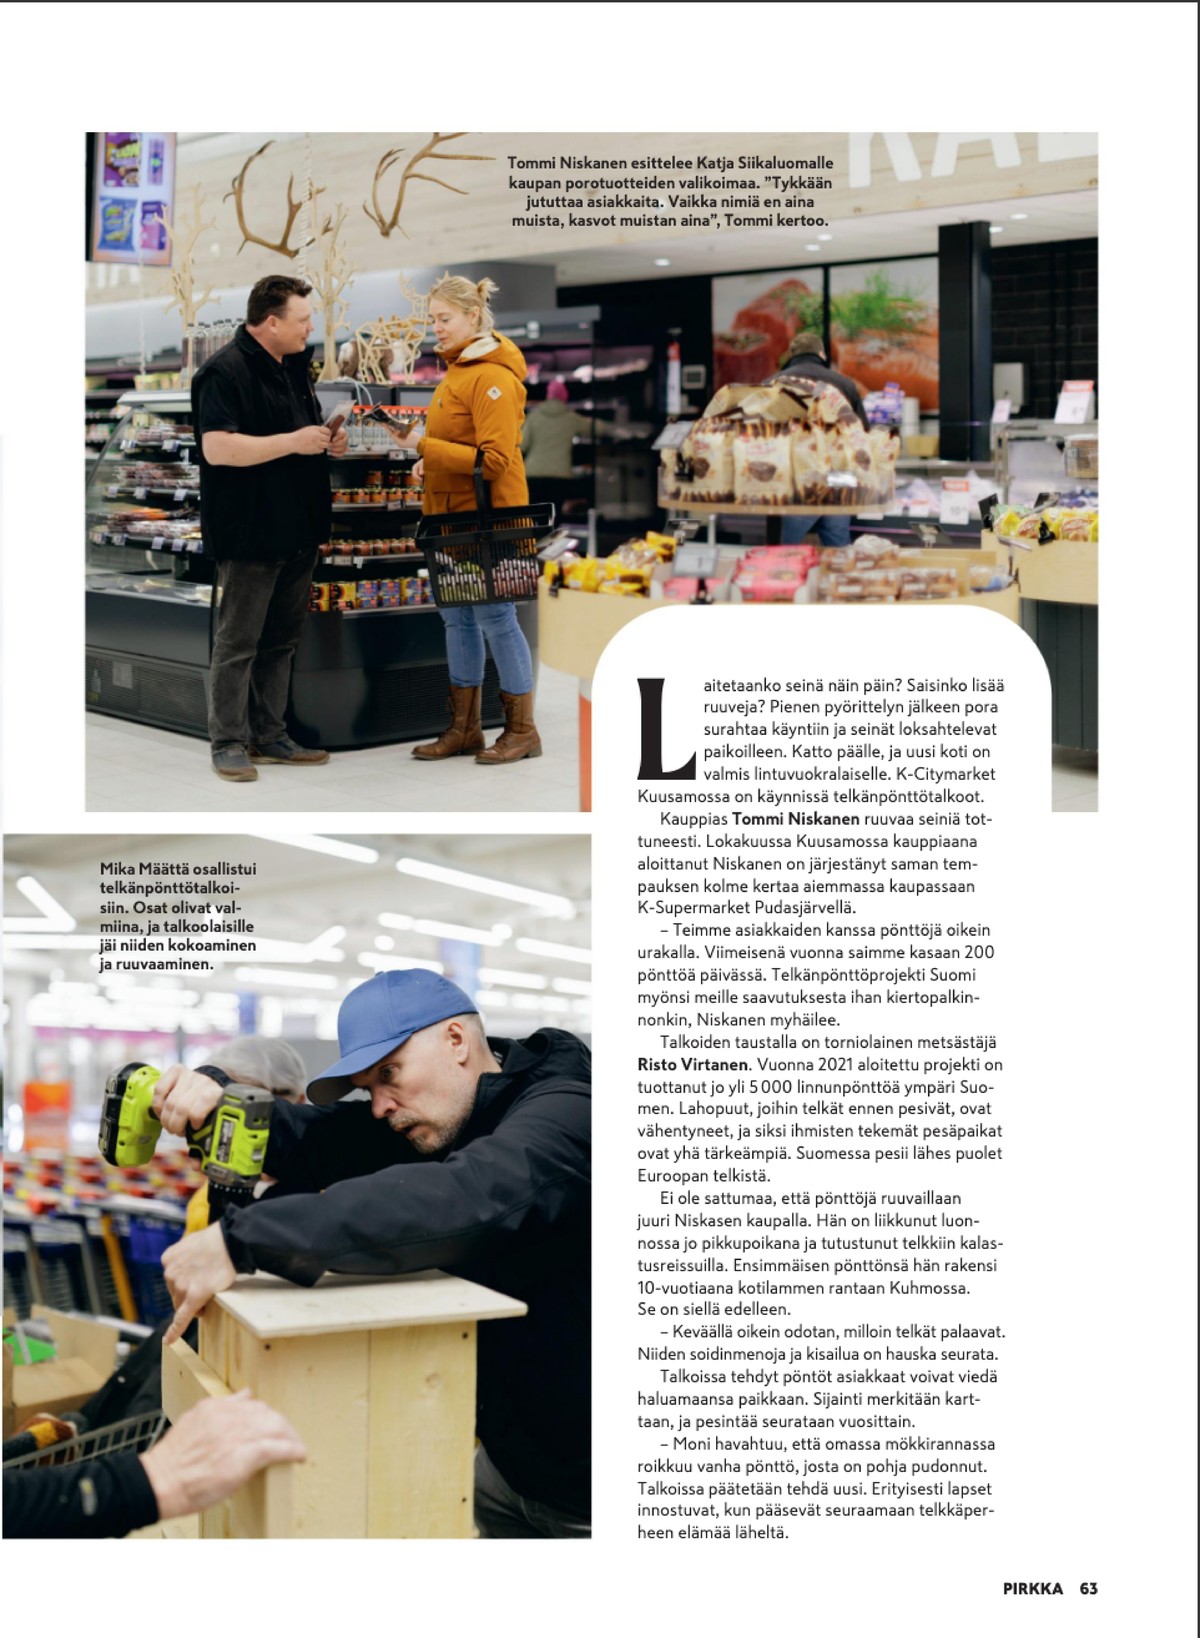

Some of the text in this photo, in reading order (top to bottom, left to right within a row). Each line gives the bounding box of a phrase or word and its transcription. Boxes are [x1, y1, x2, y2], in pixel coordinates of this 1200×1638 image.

[785, 678, 824, 692] seinä
[828, 678, 859, 692] näin
[863, 678, 903, 696] päin?
[906, 677, 968, 692] Saisinko
[972, 676, 1005, 692] lisää
[704, 720, 997, 740] surahtaa käyntiin ja seinät loksahtelevat
[703, 765, 996, 785] valmis lintuvuokralaiselle. K-Citymarket
[660, 810, 993, 829] Kauppias Tommi Niskanen ruuvaa seiniä tot-
[637, 855, 978, 875] aloittanut Niskanen on järjestänyt saman tem-
[638, 898, 857, 918] K-Supermarket Pudasjärvellä.
[637, 943, 995, 959] urakalla. Viimeisenä vuonna saimme kasaan 200
[637, 988, 980, 1008] myönsi meille saavutuksesta ihan kiertopalkin-
[659, 1033, 997, 1053] Talkoiden taustalla on torniolainen metsästäjä
[637, 1099, 992, 1119] men. Lahopuut, joihin telkät ennen pesivät, ovat
[637, 1122, 1003, 1141] vähentyneet, ja siksi ihmisten tekemät pesäpaikat
[638, 1167, 771, 1186] Euroopan telkistä.
[636, 1212, 980, 1231] juuri Niskasen kaupalla. Hän on liikkunut luon-
[637, 1257, 997, 1276] tusreissuilla. Ensimmäisen pönttönsä hän rakensi
[637, 1300, 791, 1316] Se on siellä edelleen.
[638, 1345, 999, 1365] Niiden soidinmenoja ja kisailua on hauska seurata.
[637, 1390, 981, 1410] haluamaansa paikkaan. Sijainti merkitään kart-
[637, 1457, 988, 1477] roikkuu vanha pönttö, josta on pohja pudonnut.
[637, 1480, 993, 1500] Talkoissa päätetään tehdä uusi. Erityisesti lapset
[637, 1501, 995, 1520] innostuvat, kun pääsevät seuraamaan telkkäper-
[637, 1524, 789, 1539] heen elämää läheltä.
[1003, 1582, 1099, 1595] PIRKKA 63
